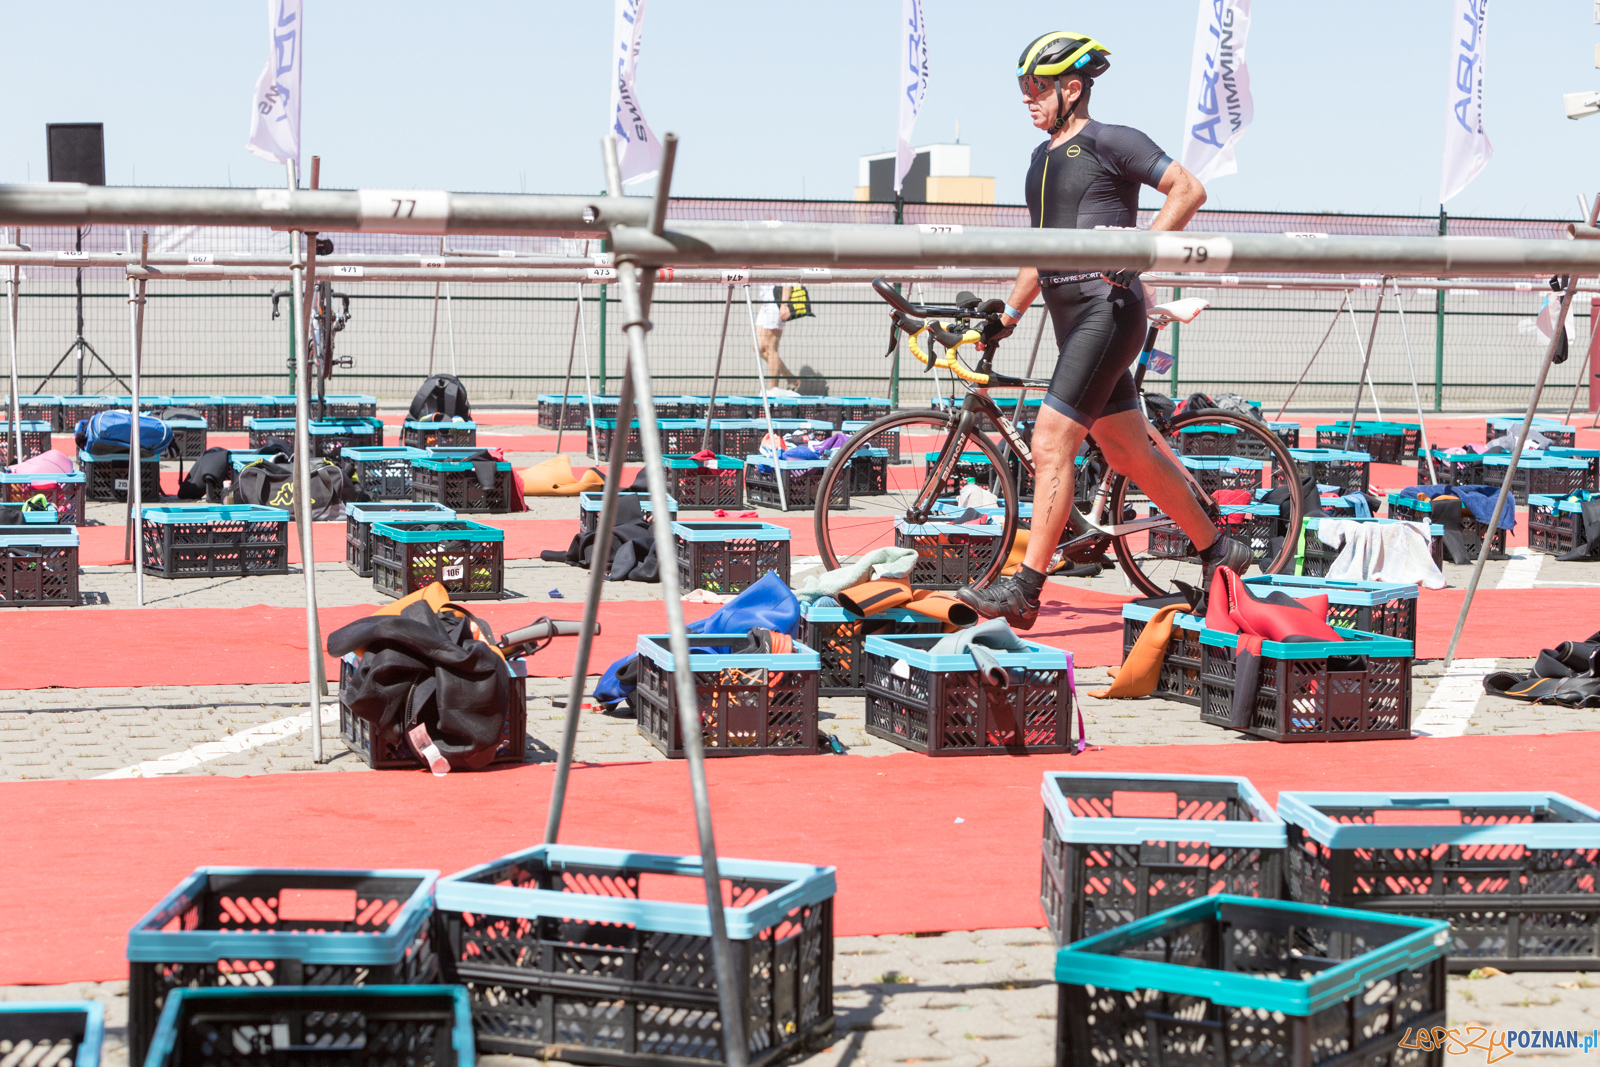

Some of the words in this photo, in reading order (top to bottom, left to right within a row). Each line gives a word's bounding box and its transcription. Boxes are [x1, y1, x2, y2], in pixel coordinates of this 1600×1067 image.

[1220, 8, 1243, 134] WIMMING
[391, 199, 417, 219] 77
[1183, 246, 1209, 264] 79
[593, 268, 611, 276] 473
[726, 274, 744, 282] 474
[941, 432, 966, 482] Bianchi
